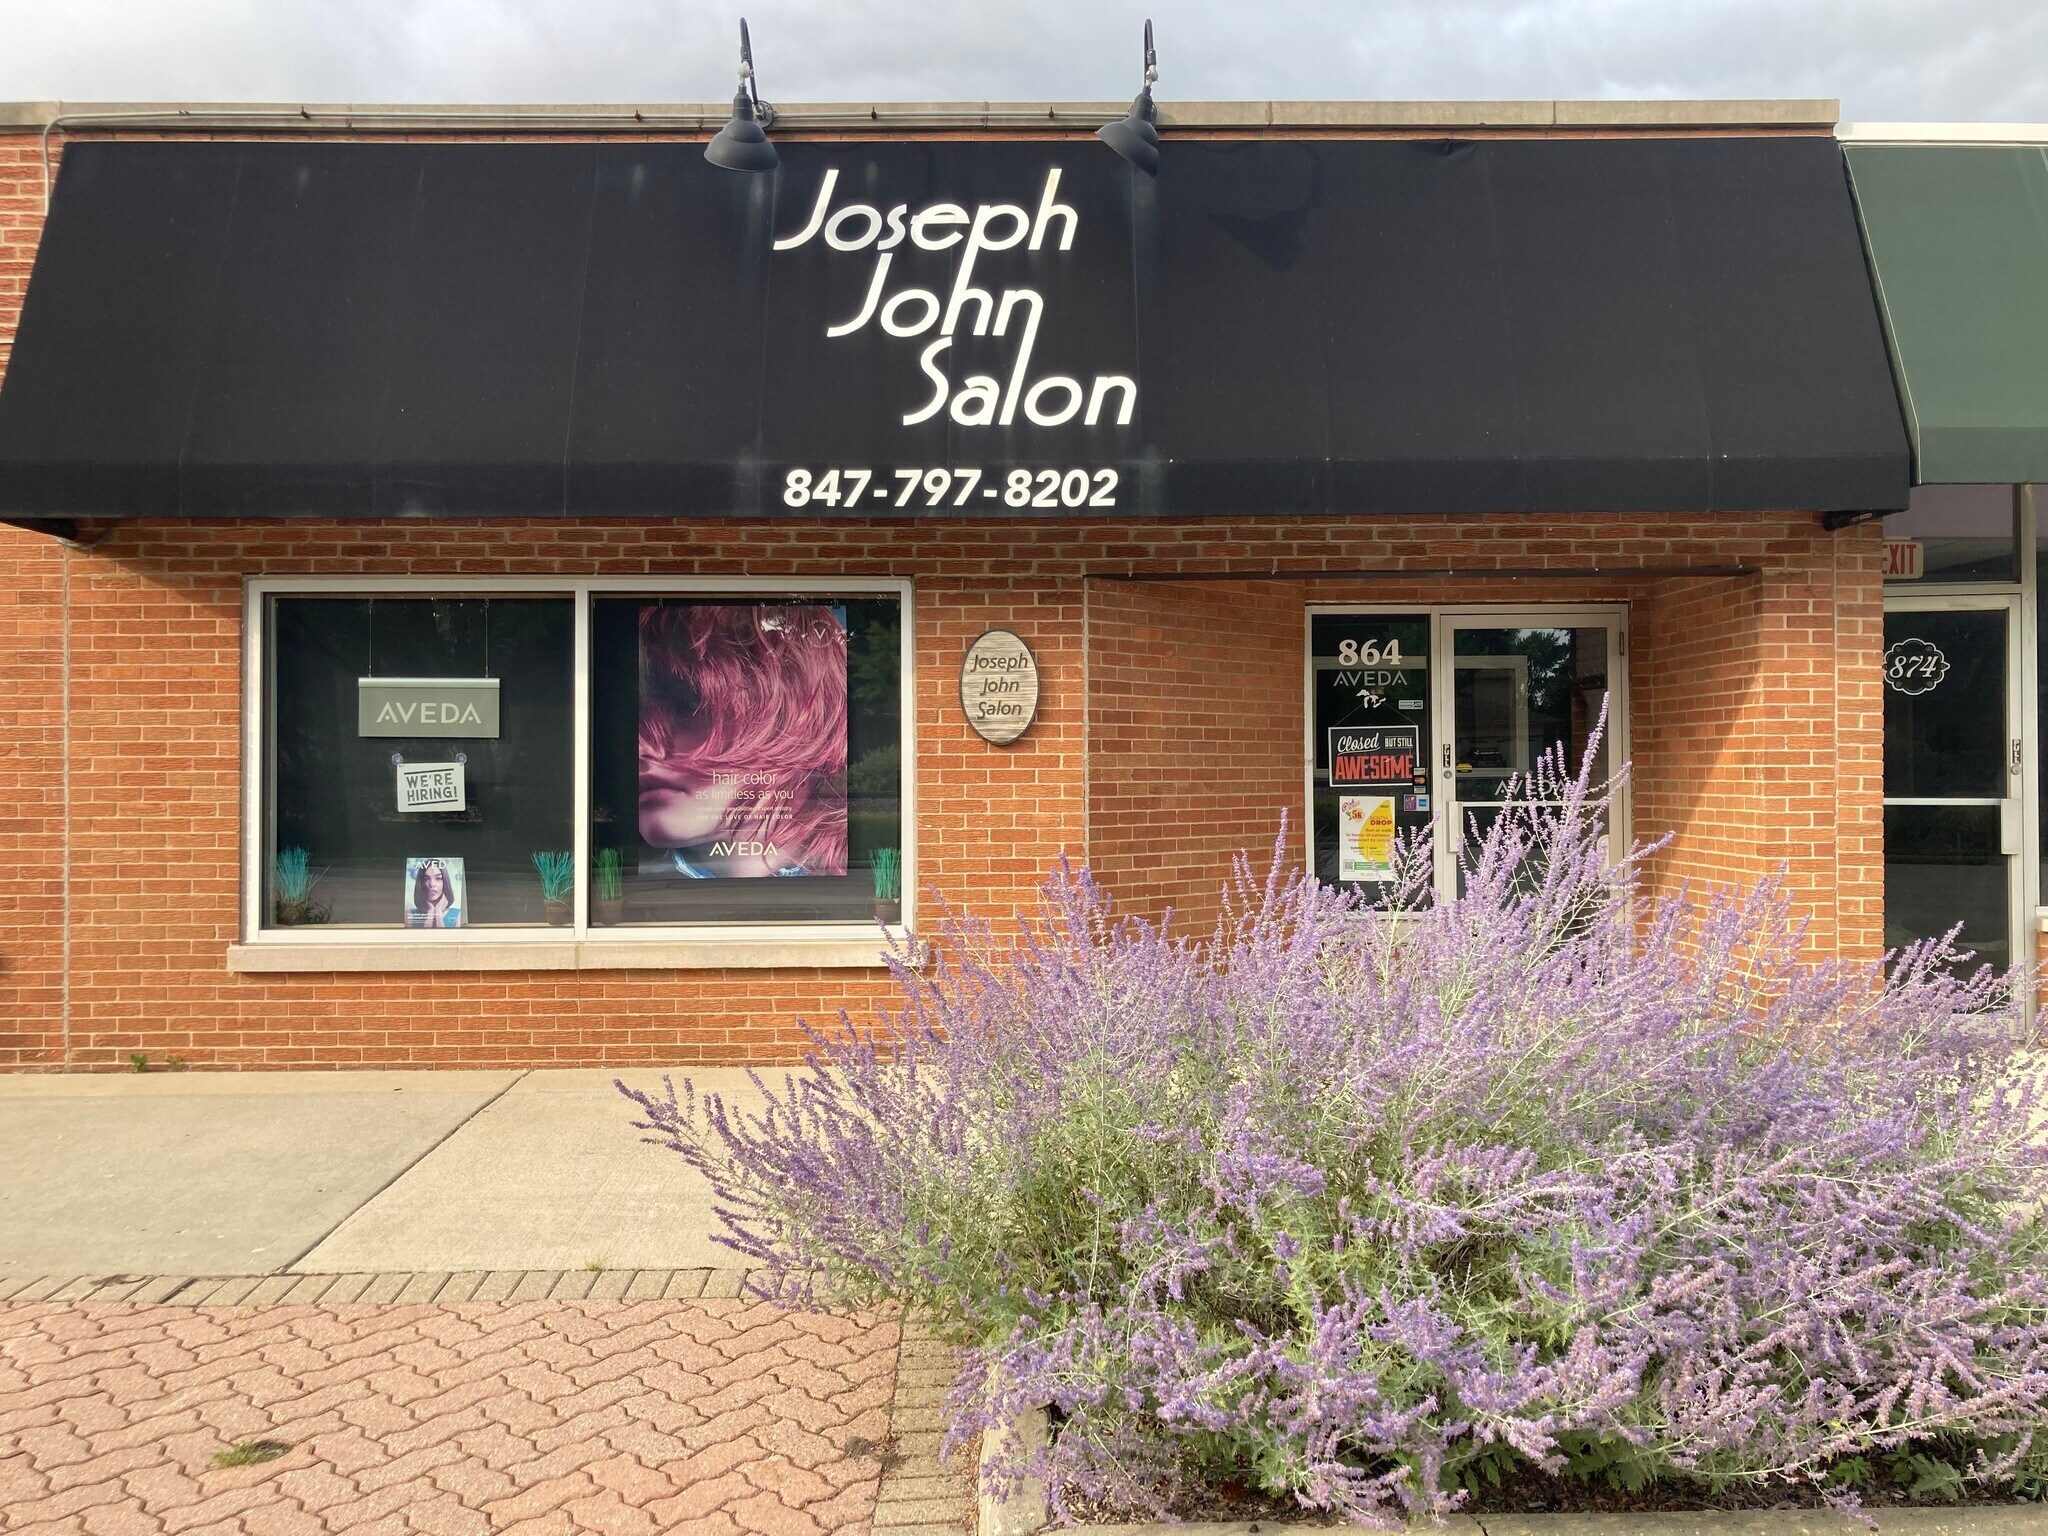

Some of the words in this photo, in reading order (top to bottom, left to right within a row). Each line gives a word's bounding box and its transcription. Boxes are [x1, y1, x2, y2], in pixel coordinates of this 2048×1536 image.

[773, 168, 1079, 252] Joseph
[827, 252, 1044, 338] John
[903, 336, 1137, 427] Salon
[783, 468, 1119, 508] 847-797-8202
[970, 652, 1028, 673] Joseph
[1338, 639, 1403, 666] 864
[1890, 655, 1939, 678] 874
[979, 677, 1019, 696] John
[1333, 671, 1408, 687] AVEDA
[376, 701, 482, 724] AVEDA
[976, 700, 1022, 720] Salon
[1337, 732, 1380, 754] Closed
[1385, 737, 1396, 747] BUT
[1397, 737, 1414, 747] STILL
[712, 769, 739, 785] hair
[743, 769, 778, 785] color
[1335, 754, 1413, 780] AWESOME
[406, 772, 453, 788] WE'RE
[407, 786, 457, 802] HIRING!
[695, 790, 708, 800] as
[711, 788, 755, 800] limitless
[758, 790, 772, 800] as
[773, 790, 794, 802] you
[709, 841, 778, 856] AVEDA
